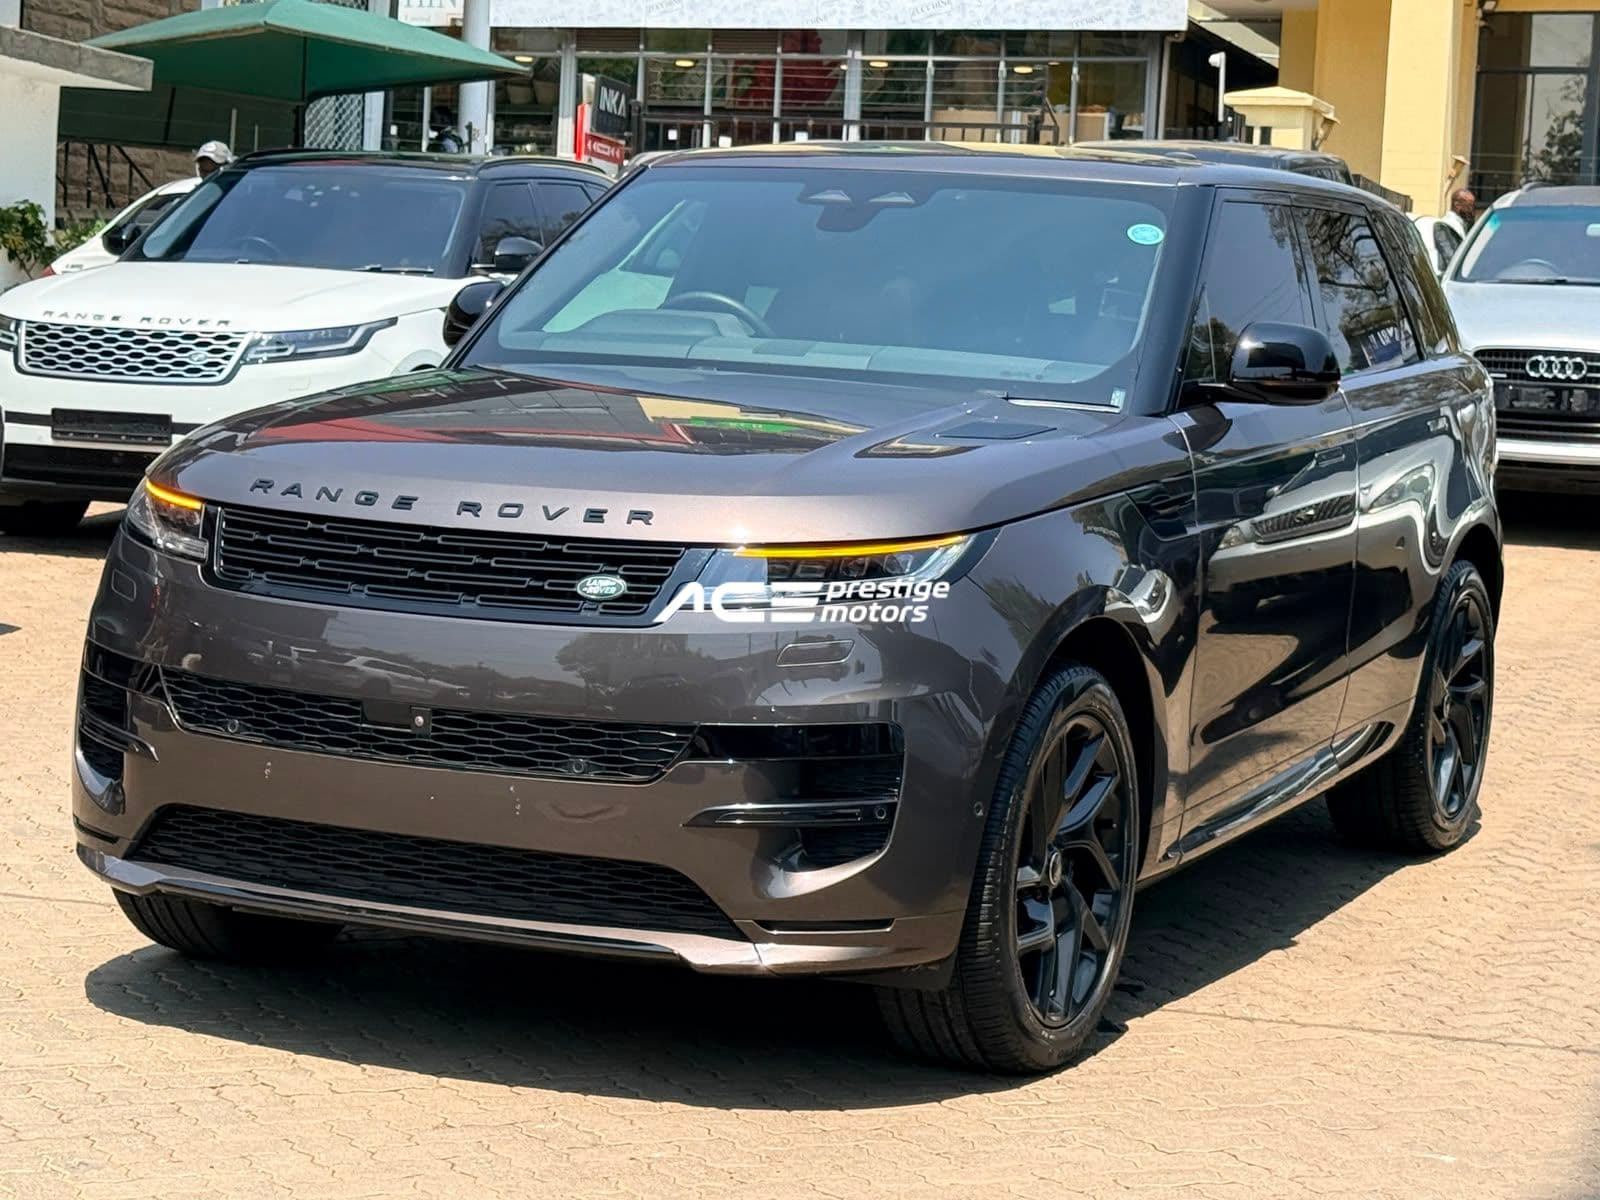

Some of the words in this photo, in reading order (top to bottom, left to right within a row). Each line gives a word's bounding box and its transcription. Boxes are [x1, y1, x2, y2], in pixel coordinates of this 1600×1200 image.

[600, 86, 626, 118] INKA
[43, 310, 122, 322] RANGE
[140, 316, 231, 326] ROVER
[249, 477, 420, 511] RANGE
[456, 500, 656, 526] ROVER
[586, 586, 617, 594] ROVER
